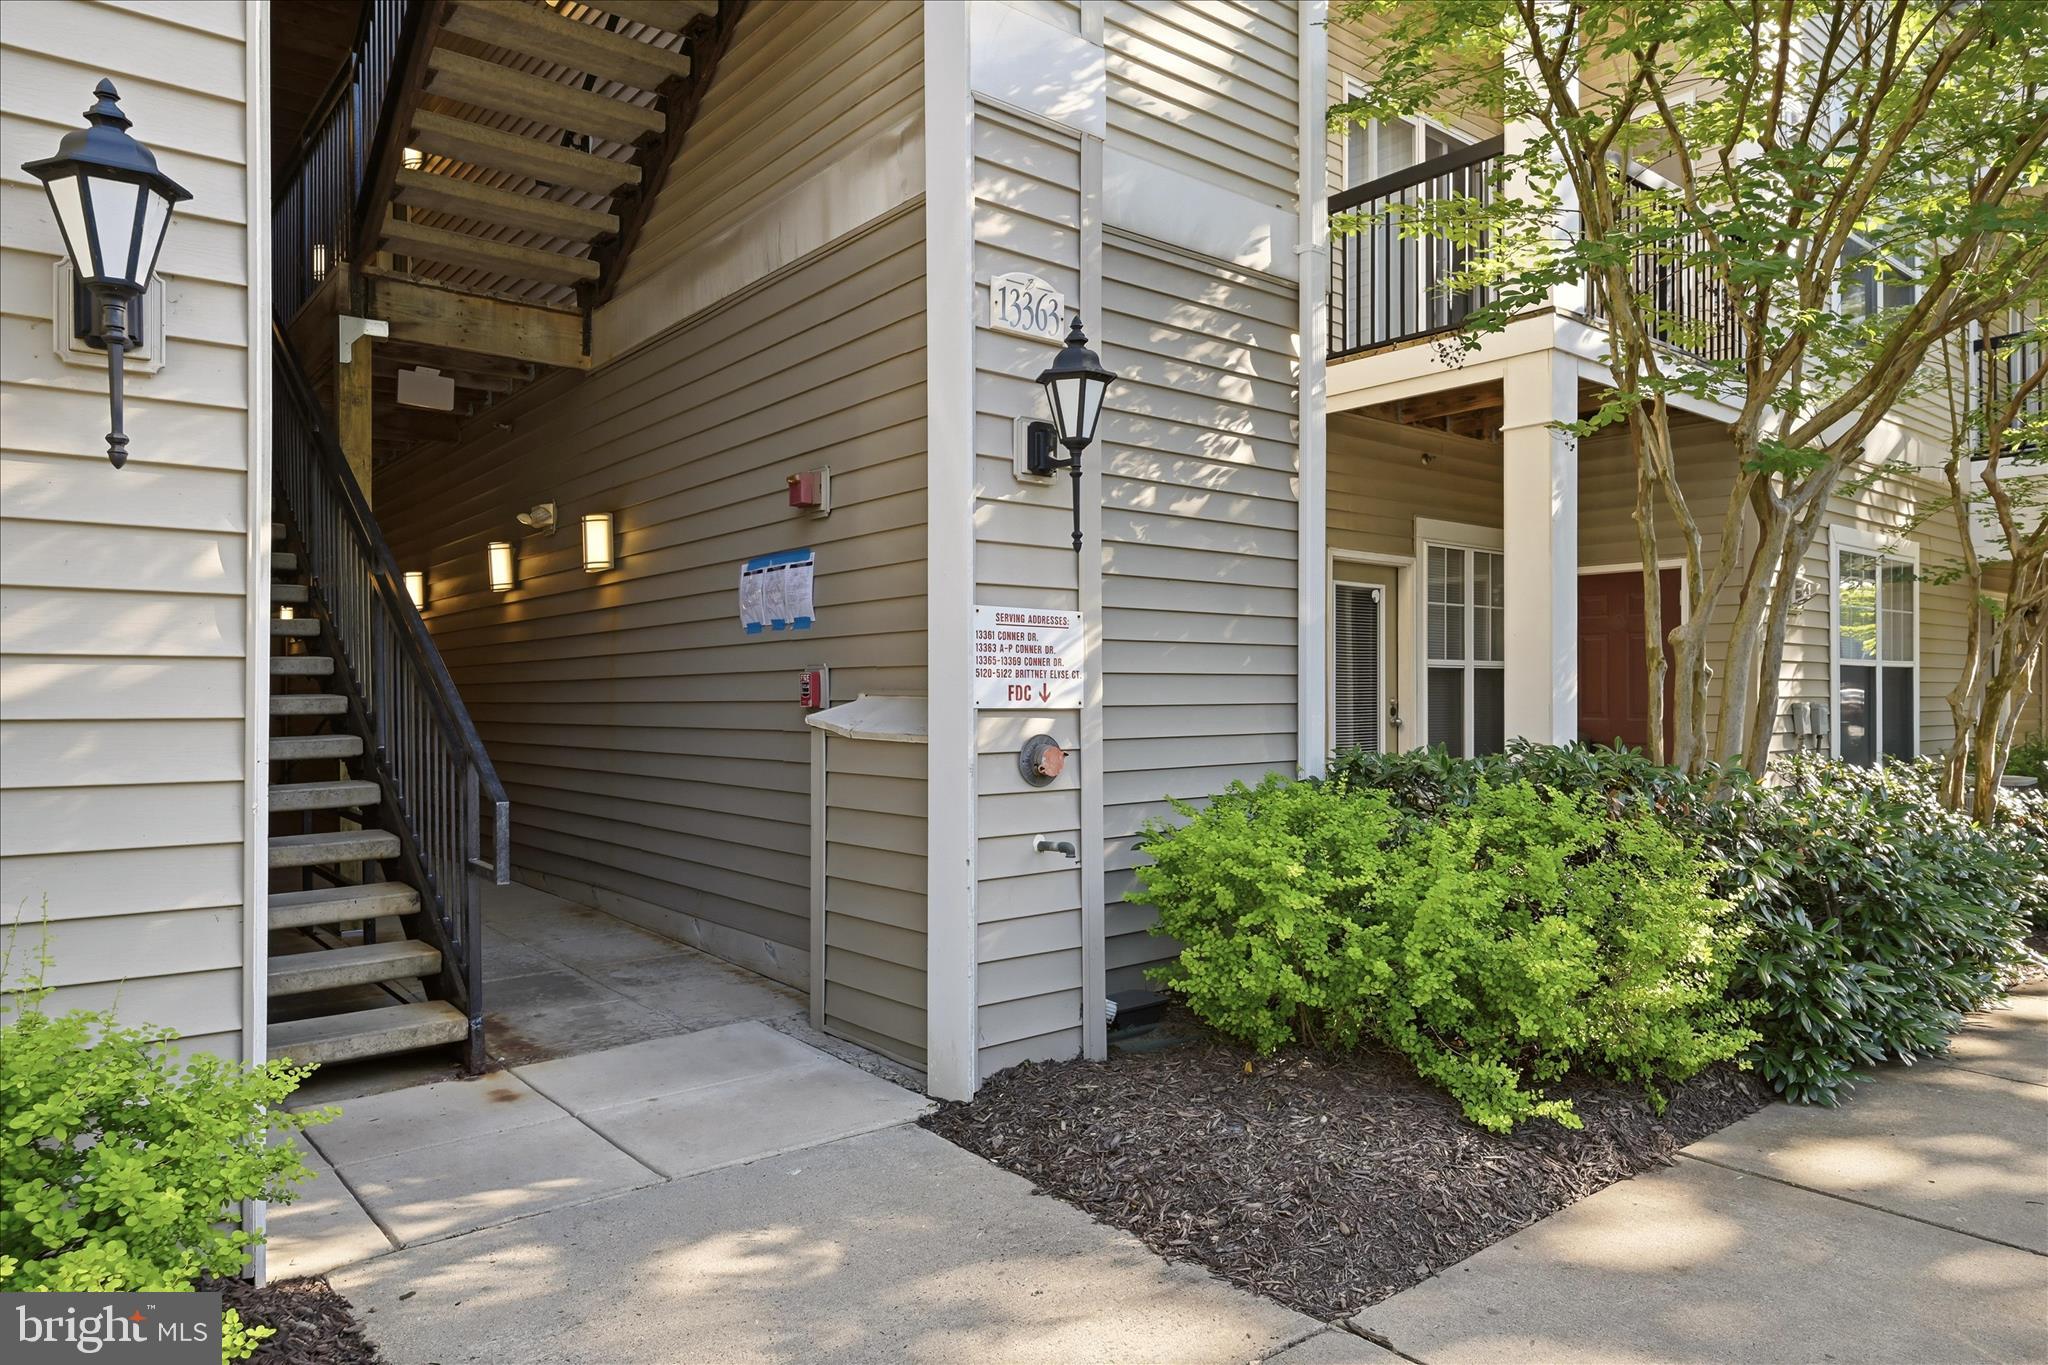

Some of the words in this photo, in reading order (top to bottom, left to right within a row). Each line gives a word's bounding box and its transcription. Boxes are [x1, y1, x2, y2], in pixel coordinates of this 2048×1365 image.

[998, 286, 1059, 336] 13363
[996, 613, 1025, 623] SERVING
[1028, 615, 1069, 625] ADDRESSES:
[976, 630, 995, 639] 13361
[998, 631, 1025, 641] CONNER
[1028, 632, 1039, 641] DR.
[976, 643, 996, 652] 13363
[1000, 644, 1012, 653] A-P
[1016, 644, 1042, 654] CONNER
[1045, 646, 1056, 654] DR.
[976, 656, 1021, 665] 13365-13369
[1024, 657, 1051, 666] CONNER
[1053, 658, 1064, 667] DR.
[976, 669, 1012, 678] 5120-5122
[1016, 670, 1047, 678] BRITTNEY
[1050, 670, 1069, 679] ELYSE
[1072, 671, 1082, 679] CT.
[1008, 685, 1031, 701] FDC
